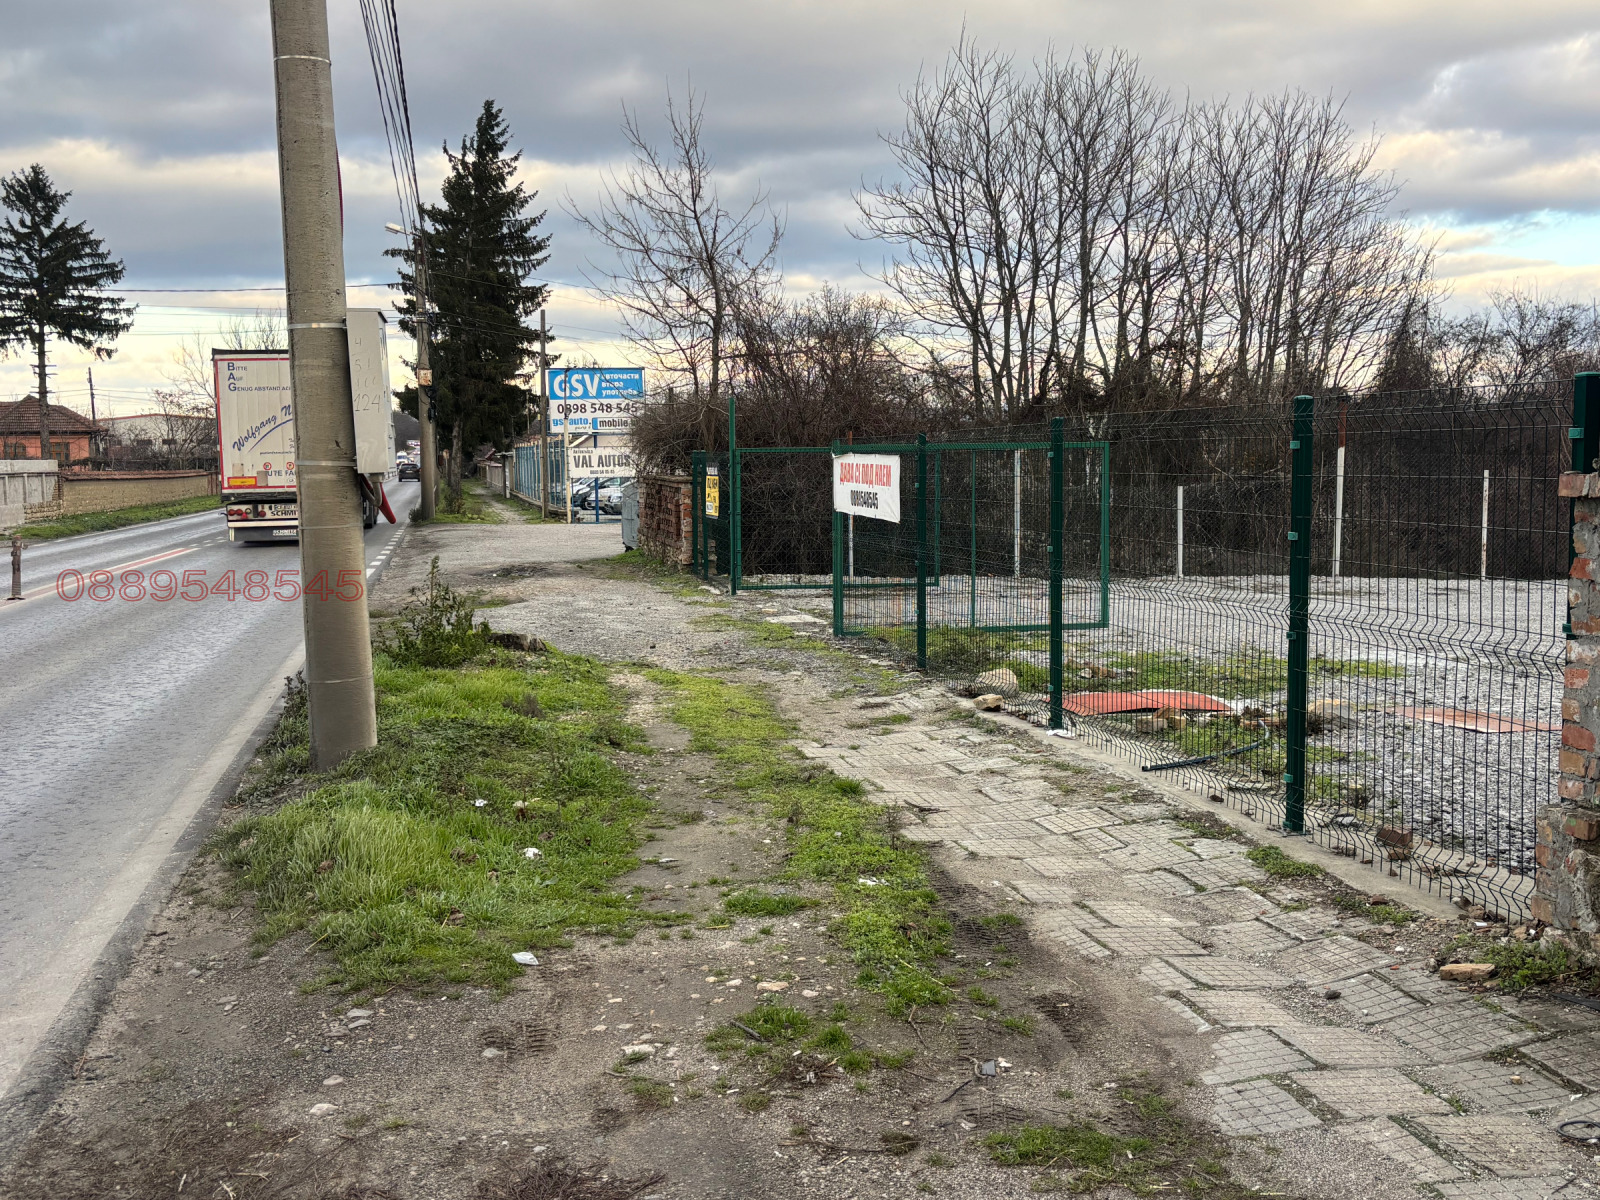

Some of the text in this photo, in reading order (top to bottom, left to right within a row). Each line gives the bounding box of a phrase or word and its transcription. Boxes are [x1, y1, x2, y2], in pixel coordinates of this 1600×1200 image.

[227, 361, 248, 371] BITTE
[228, 382, 254, 392] GENUG
[553, 373, 600, 398] GSV
[354, 393, 381, 414] 124
[590, 402, 613, 413] 548
[616, 402, 638, 413] 545
[232, 414, 278, 452] Wolfgang
[573, 454, 631, 468] VAL AUTOS
[267, 469, 283, 477] UTE
